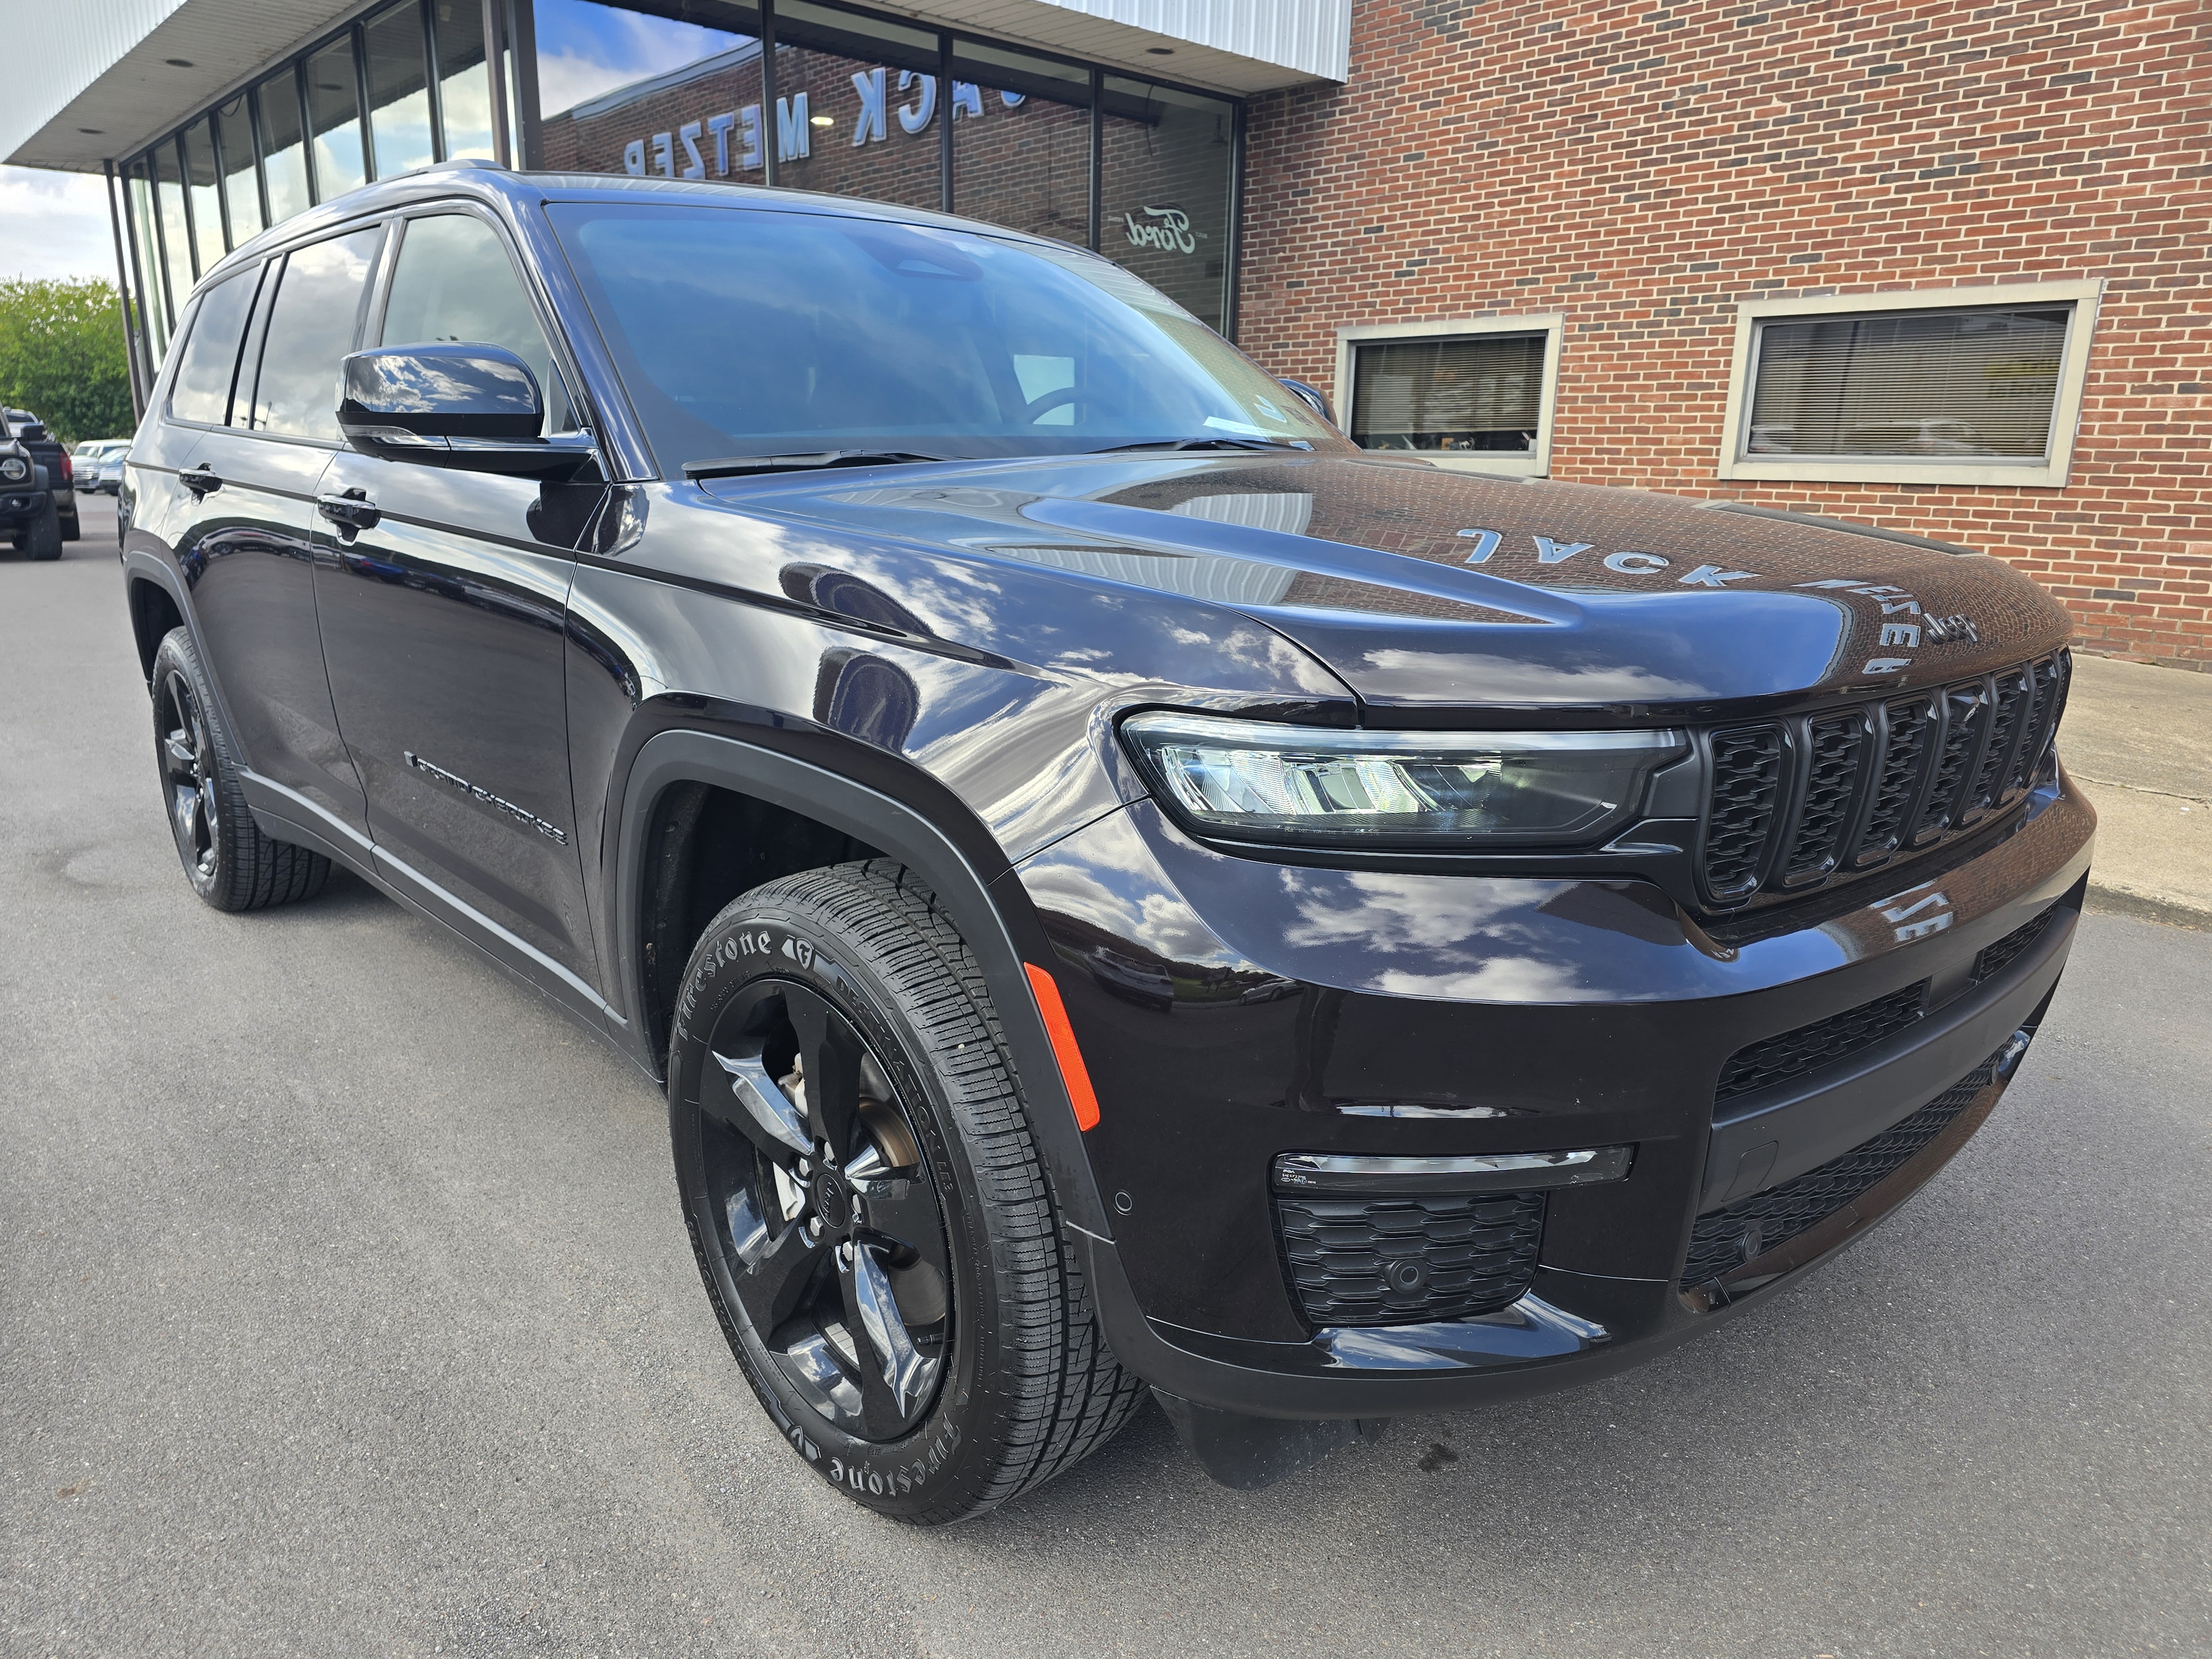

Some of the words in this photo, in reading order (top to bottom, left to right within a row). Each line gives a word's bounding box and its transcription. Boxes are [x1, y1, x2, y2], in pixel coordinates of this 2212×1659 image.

[1922, 612, 1979, 645] Jeep
[676, 930, 773, 1042] Firestone
[836, 974, 941, 1154] DESTINATION
[830, 1412, 963, 1496] Firestone
